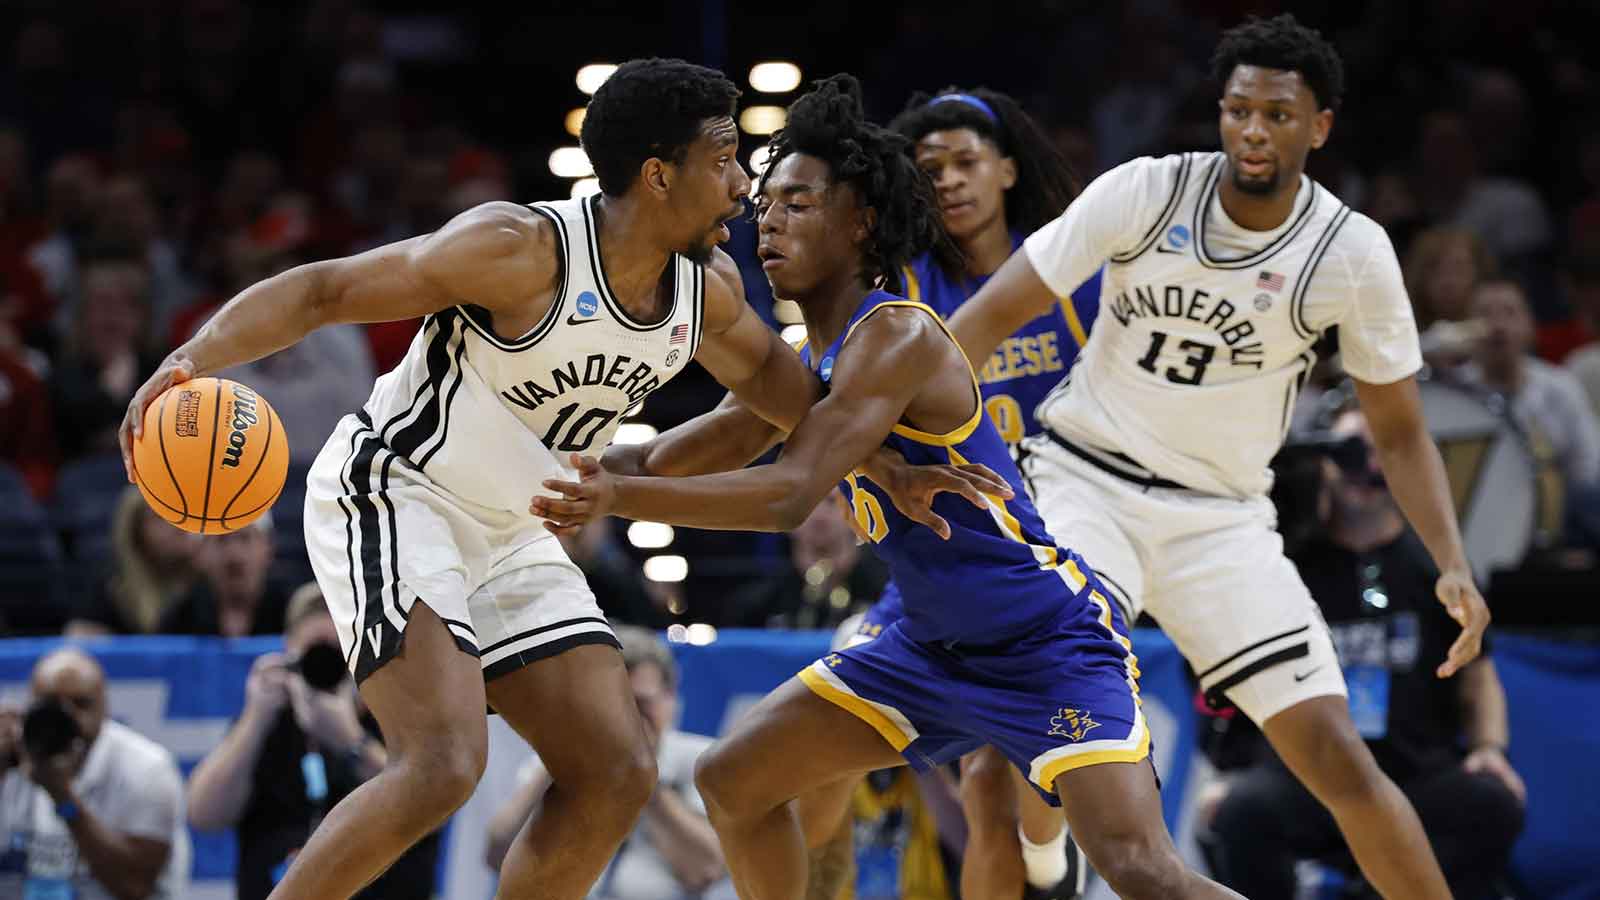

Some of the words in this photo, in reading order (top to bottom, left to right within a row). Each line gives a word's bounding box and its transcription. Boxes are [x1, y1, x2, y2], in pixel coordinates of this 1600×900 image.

[501, 353, 660, 412] VANDERB
[1137, 331, 1217, 386] 13
[222, 383, 256, 469] Wilson
[541, 402, 619, 452] 10
[367, 623, 382, 659] V
